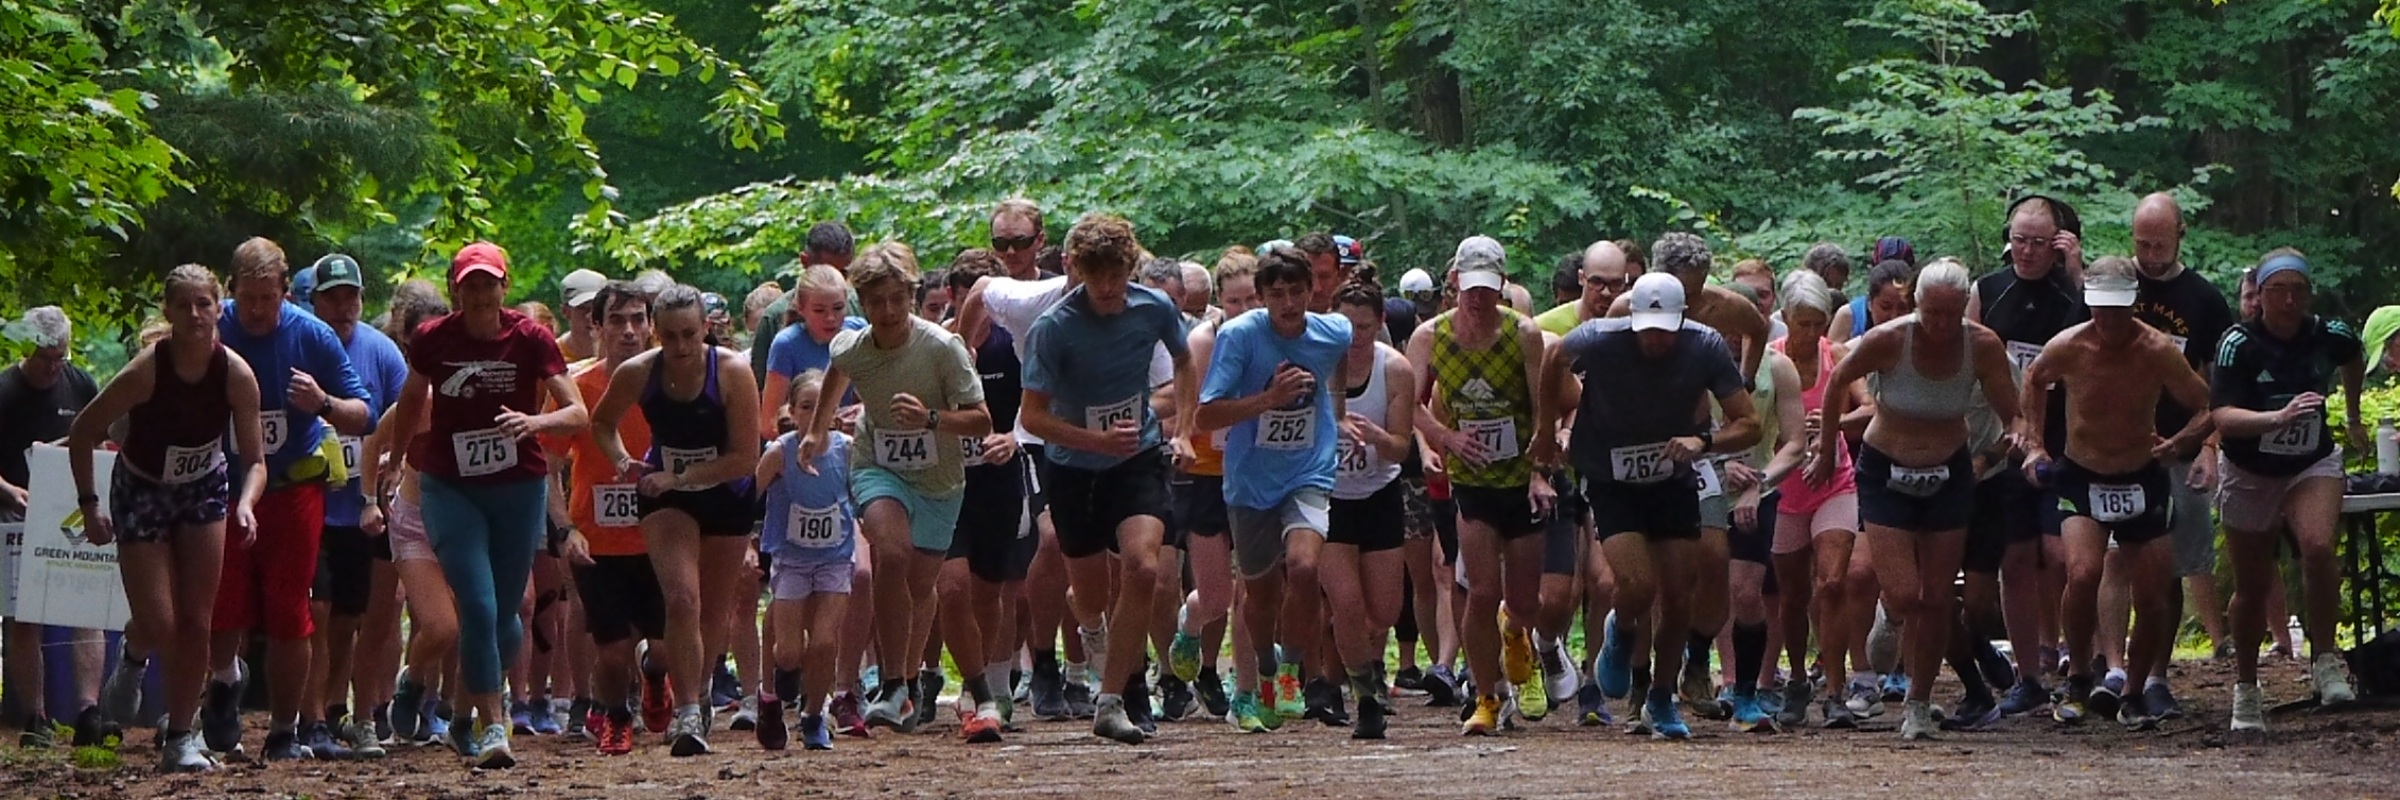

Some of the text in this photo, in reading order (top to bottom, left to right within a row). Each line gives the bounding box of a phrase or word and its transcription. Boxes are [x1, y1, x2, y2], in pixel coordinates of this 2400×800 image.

[1267, 419, 1307, 443] 252
[2272, 421, 2312, 447] 251
[466, 437, 507, 467] 275
[885, 437, 927, 463] 244
[173, 451, 213, 477] 304
[1622, 452, 1665, 481] 262
[2099, 493, 2134, 515] 185
[798, 515, 833, 540] 190
[34, 546, 70, 560] GREEN
